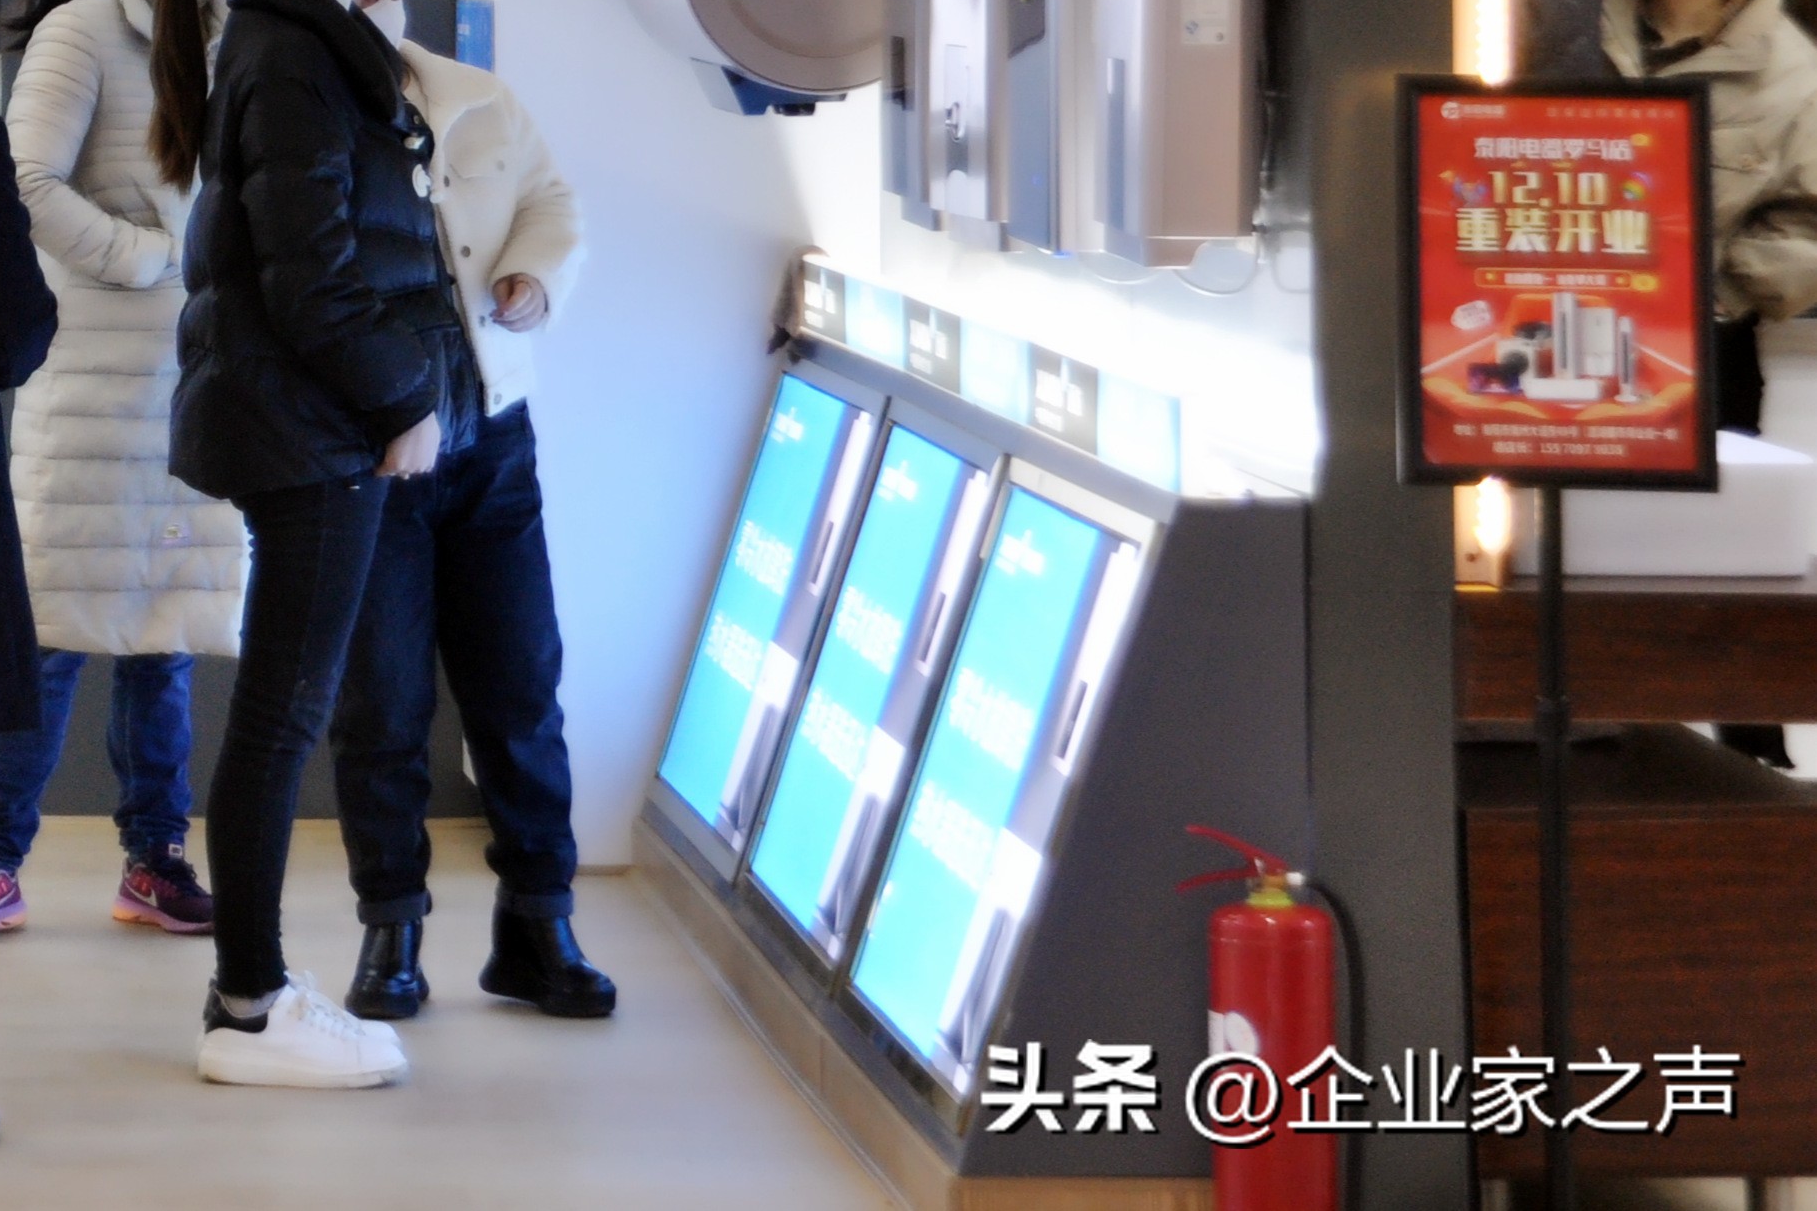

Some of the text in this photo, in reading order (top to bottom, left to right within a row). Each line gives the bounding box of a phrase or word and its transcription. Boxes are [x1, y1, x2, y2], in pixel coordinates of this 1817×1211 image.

[1488, 171, 1608, 207] 12.10
[1455, 208, 1650, 254] 重装开业
